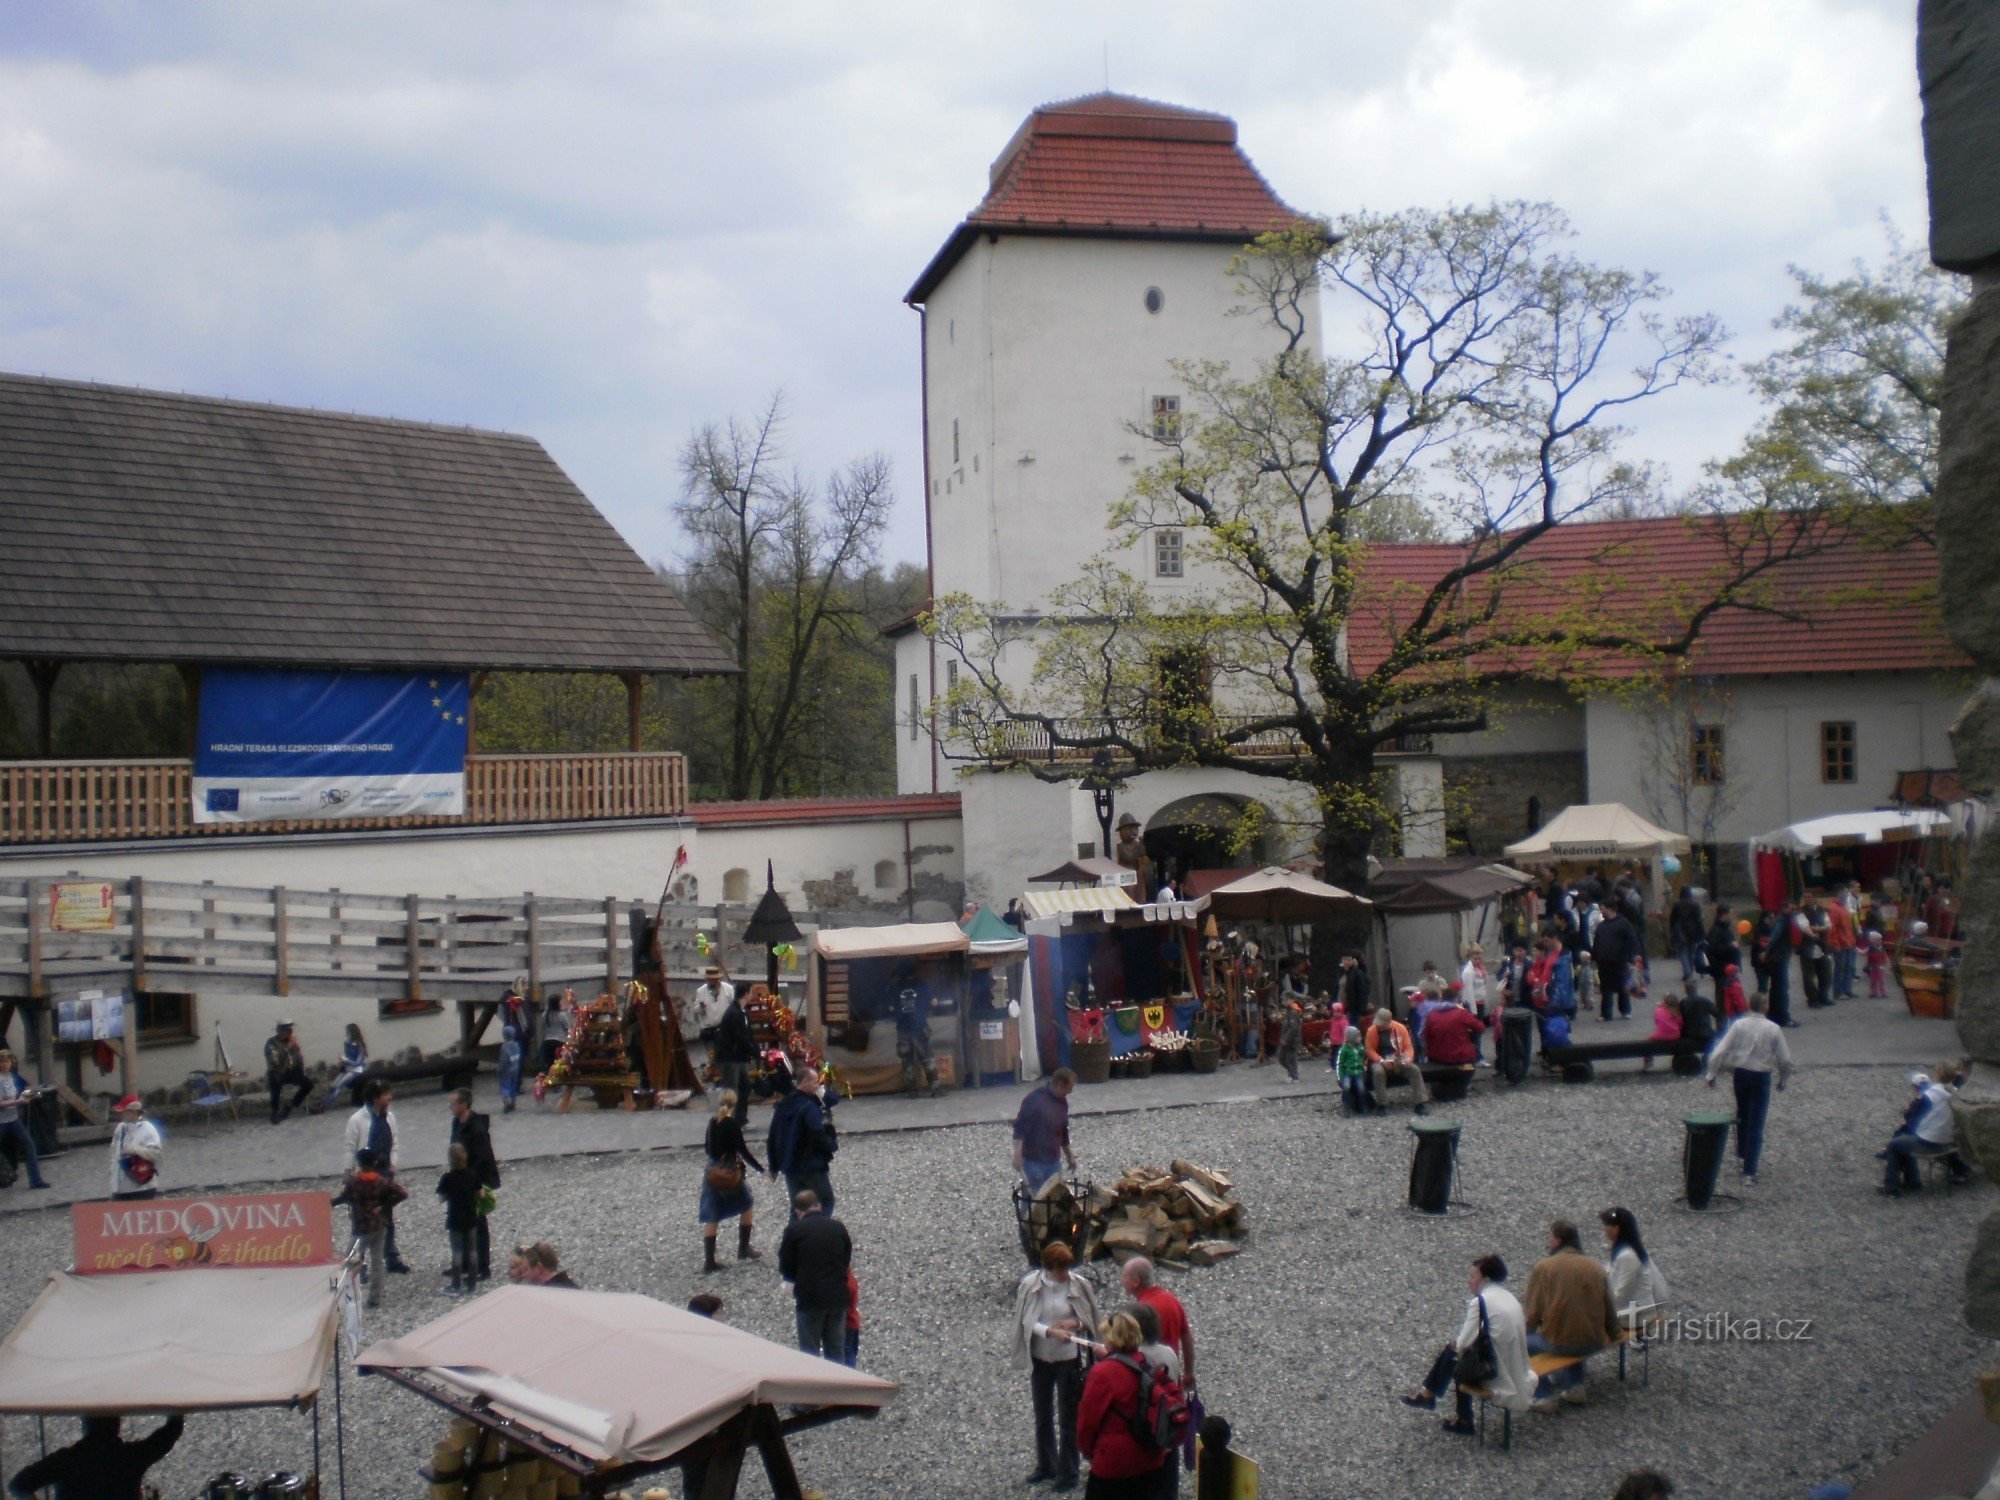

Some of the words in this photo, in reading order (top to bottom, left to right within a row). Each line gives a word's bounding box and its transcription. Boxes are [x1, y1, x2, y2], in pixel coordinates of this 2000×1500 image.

[210, 742, 243, 752] HRADNÍ
[245, 744, 277, 752] TERASA
[368, 743, 393, 752] HRADU
[101, 1201, 305, 1237] MEDOVINA
